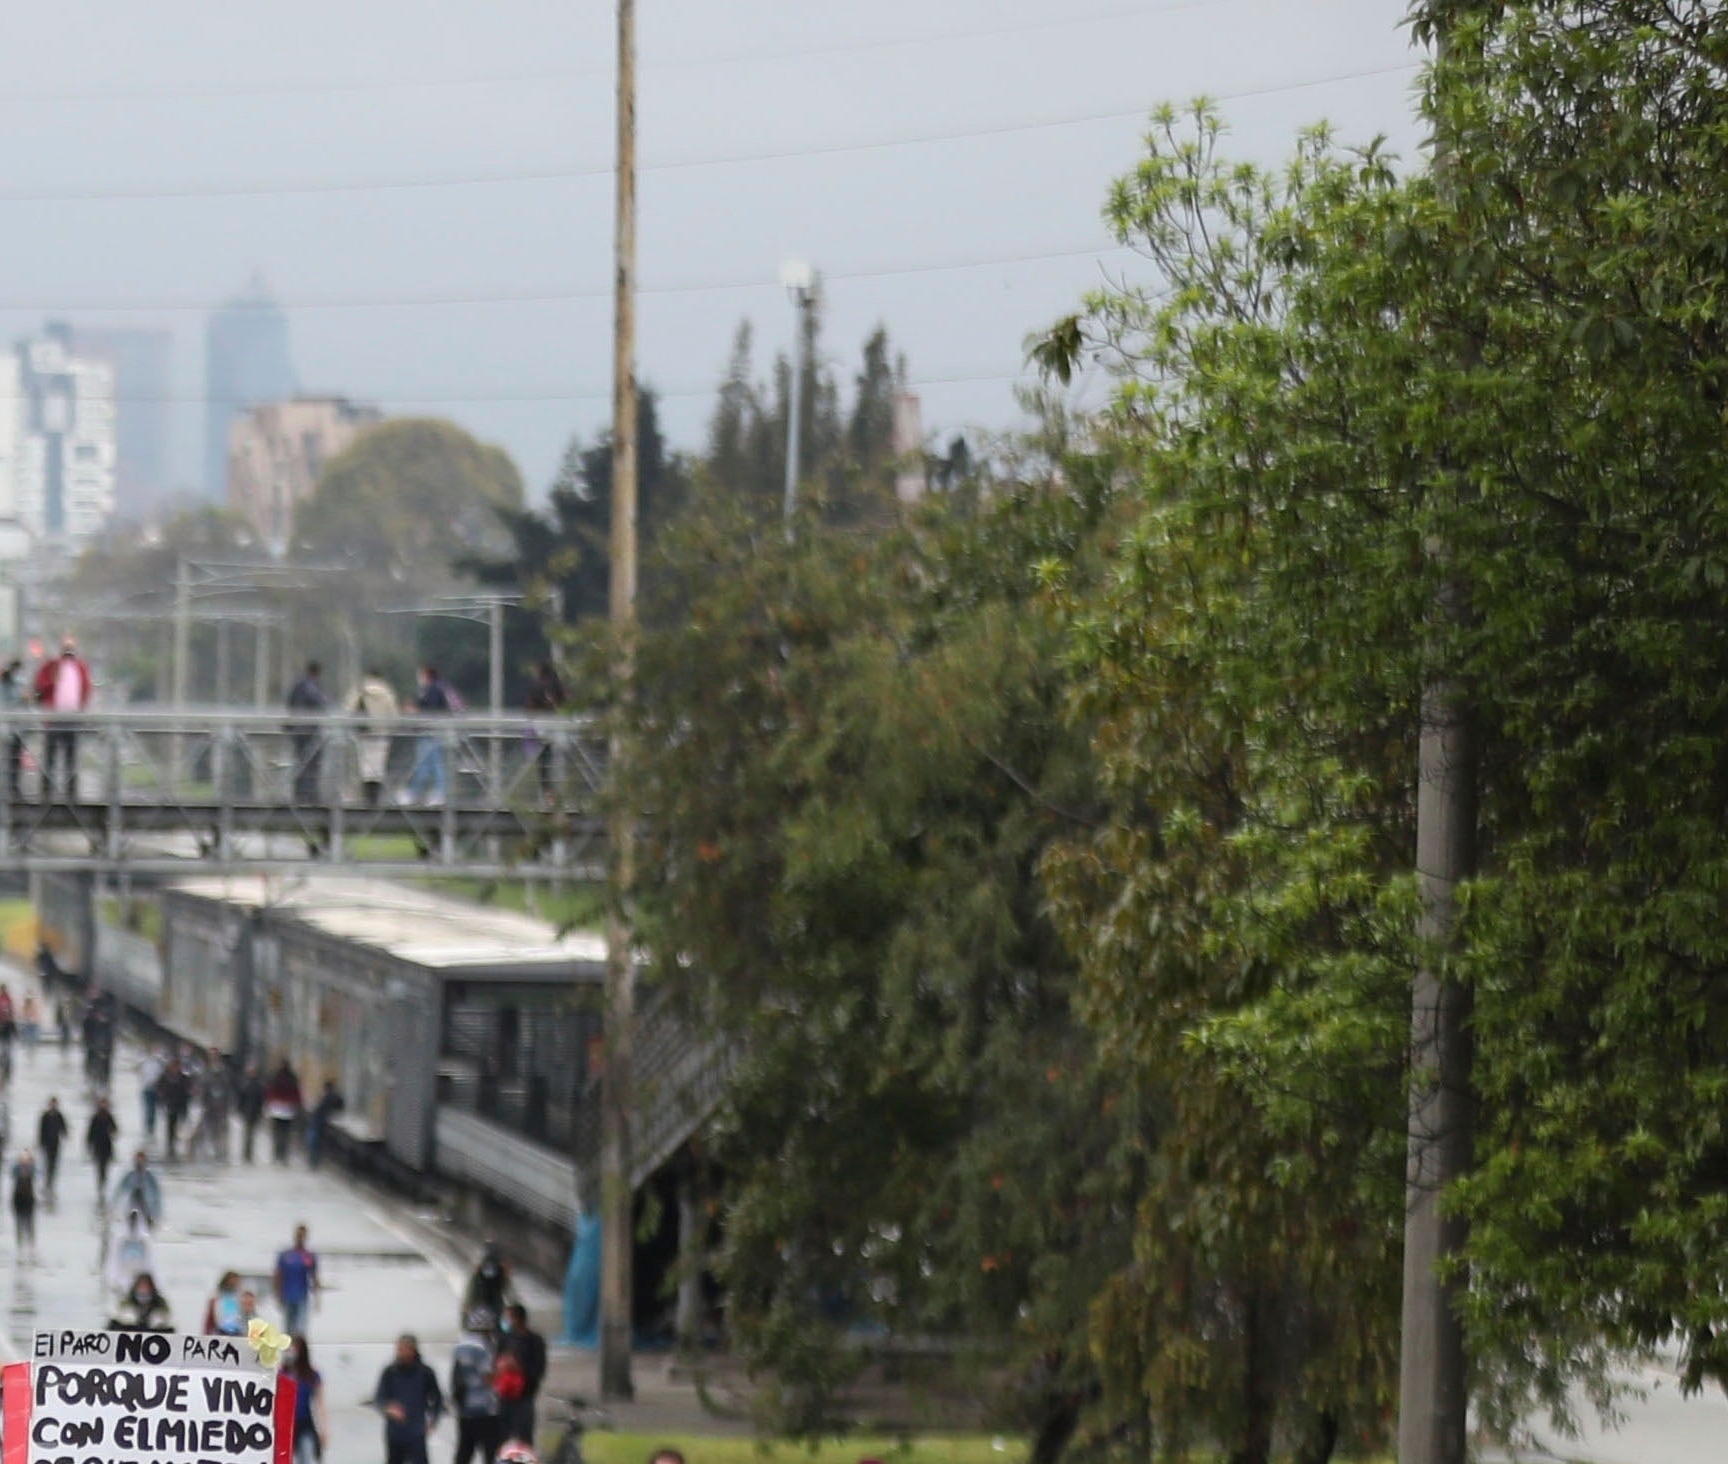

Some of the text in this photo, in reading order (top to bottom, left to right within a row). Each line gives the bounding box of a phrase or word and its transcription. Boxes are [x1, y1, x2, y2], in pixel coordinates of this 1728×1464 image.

[61, 1330, 111, 1356] PARO
[115, 1333, 171, 1365] NO
[183, 1338, 240, 1365] PARA
[36, 1366, 190, 1413] PORQUE
[32, 1417, 104, 1449] CON
